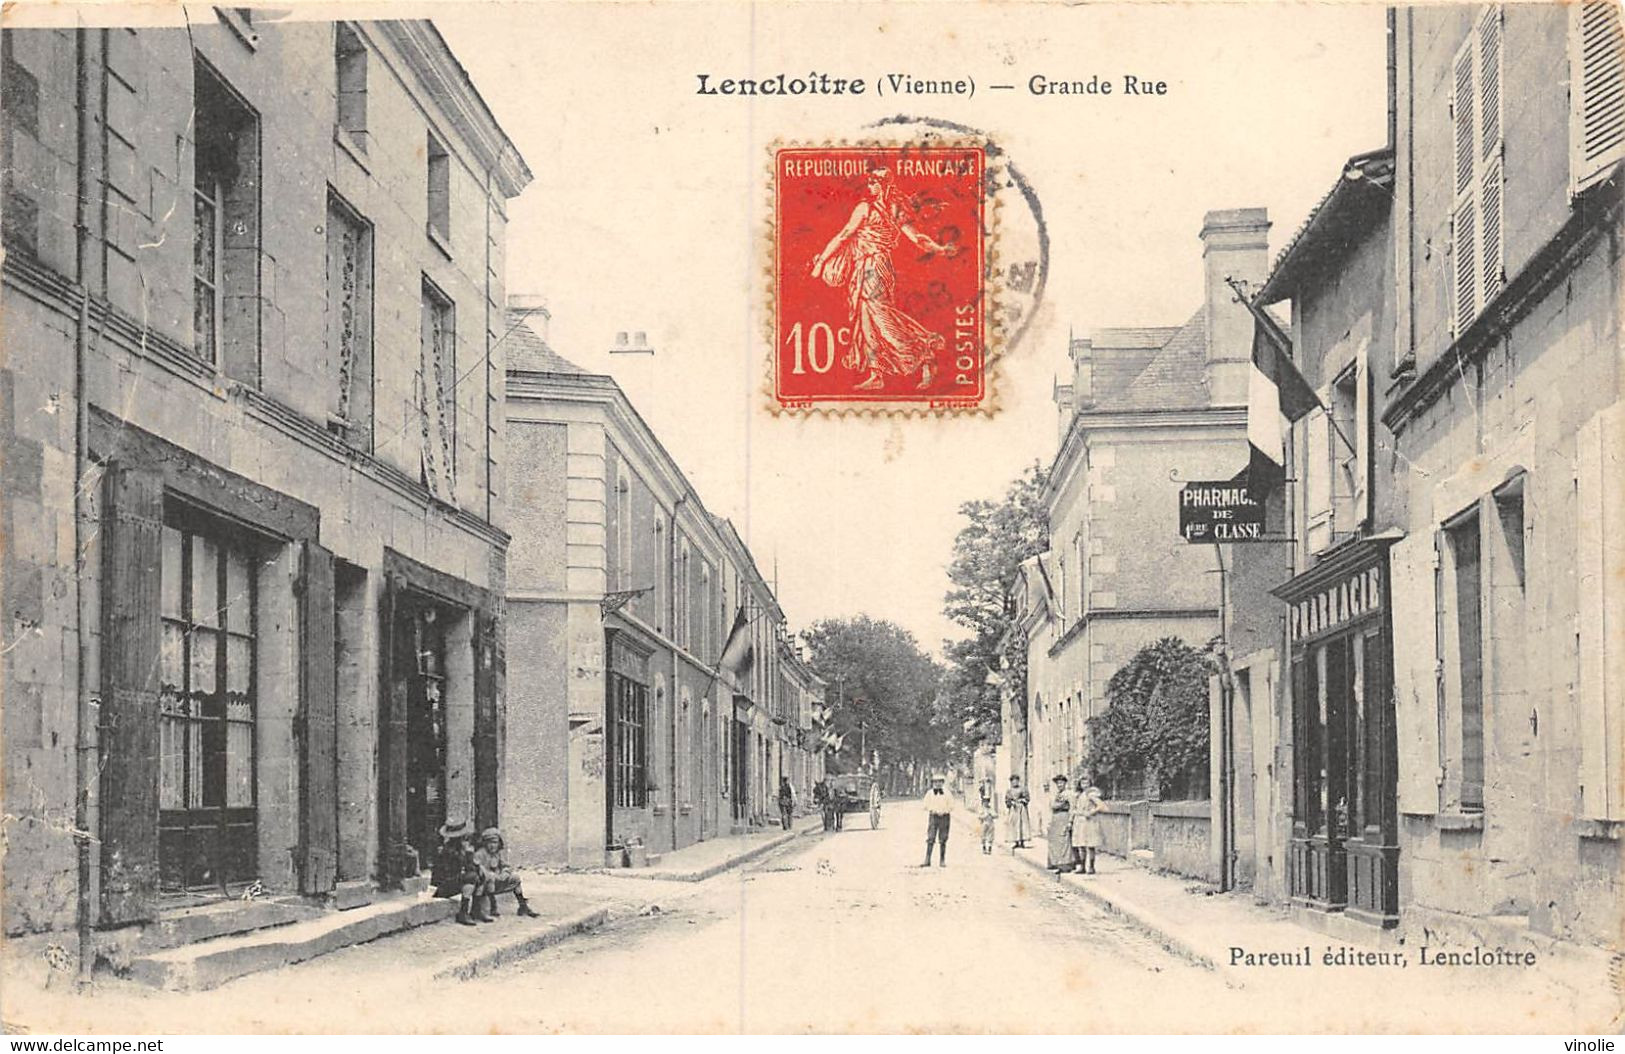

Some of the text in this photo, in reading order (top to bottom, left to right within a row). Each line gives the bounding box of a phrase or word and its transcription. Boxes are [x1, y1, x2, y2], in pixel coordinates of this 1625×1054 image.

[696, 73, 866, 95] Lencloître
[876, 74, 976, 98] (Vienne)
[1028, 74, 1113, 95] Grande
[1123, 75, 1168, 95] Rue
[955, 303, 975, 385] POSTES
[1213, 510, 1233, 519] DE
[1214, 523, 1260, 539] CLASSE
[1292, 566, 1379, 641] PHARMACIE
[1230, 946, 1537, 968] Pareuil éditeur, Lencloître
